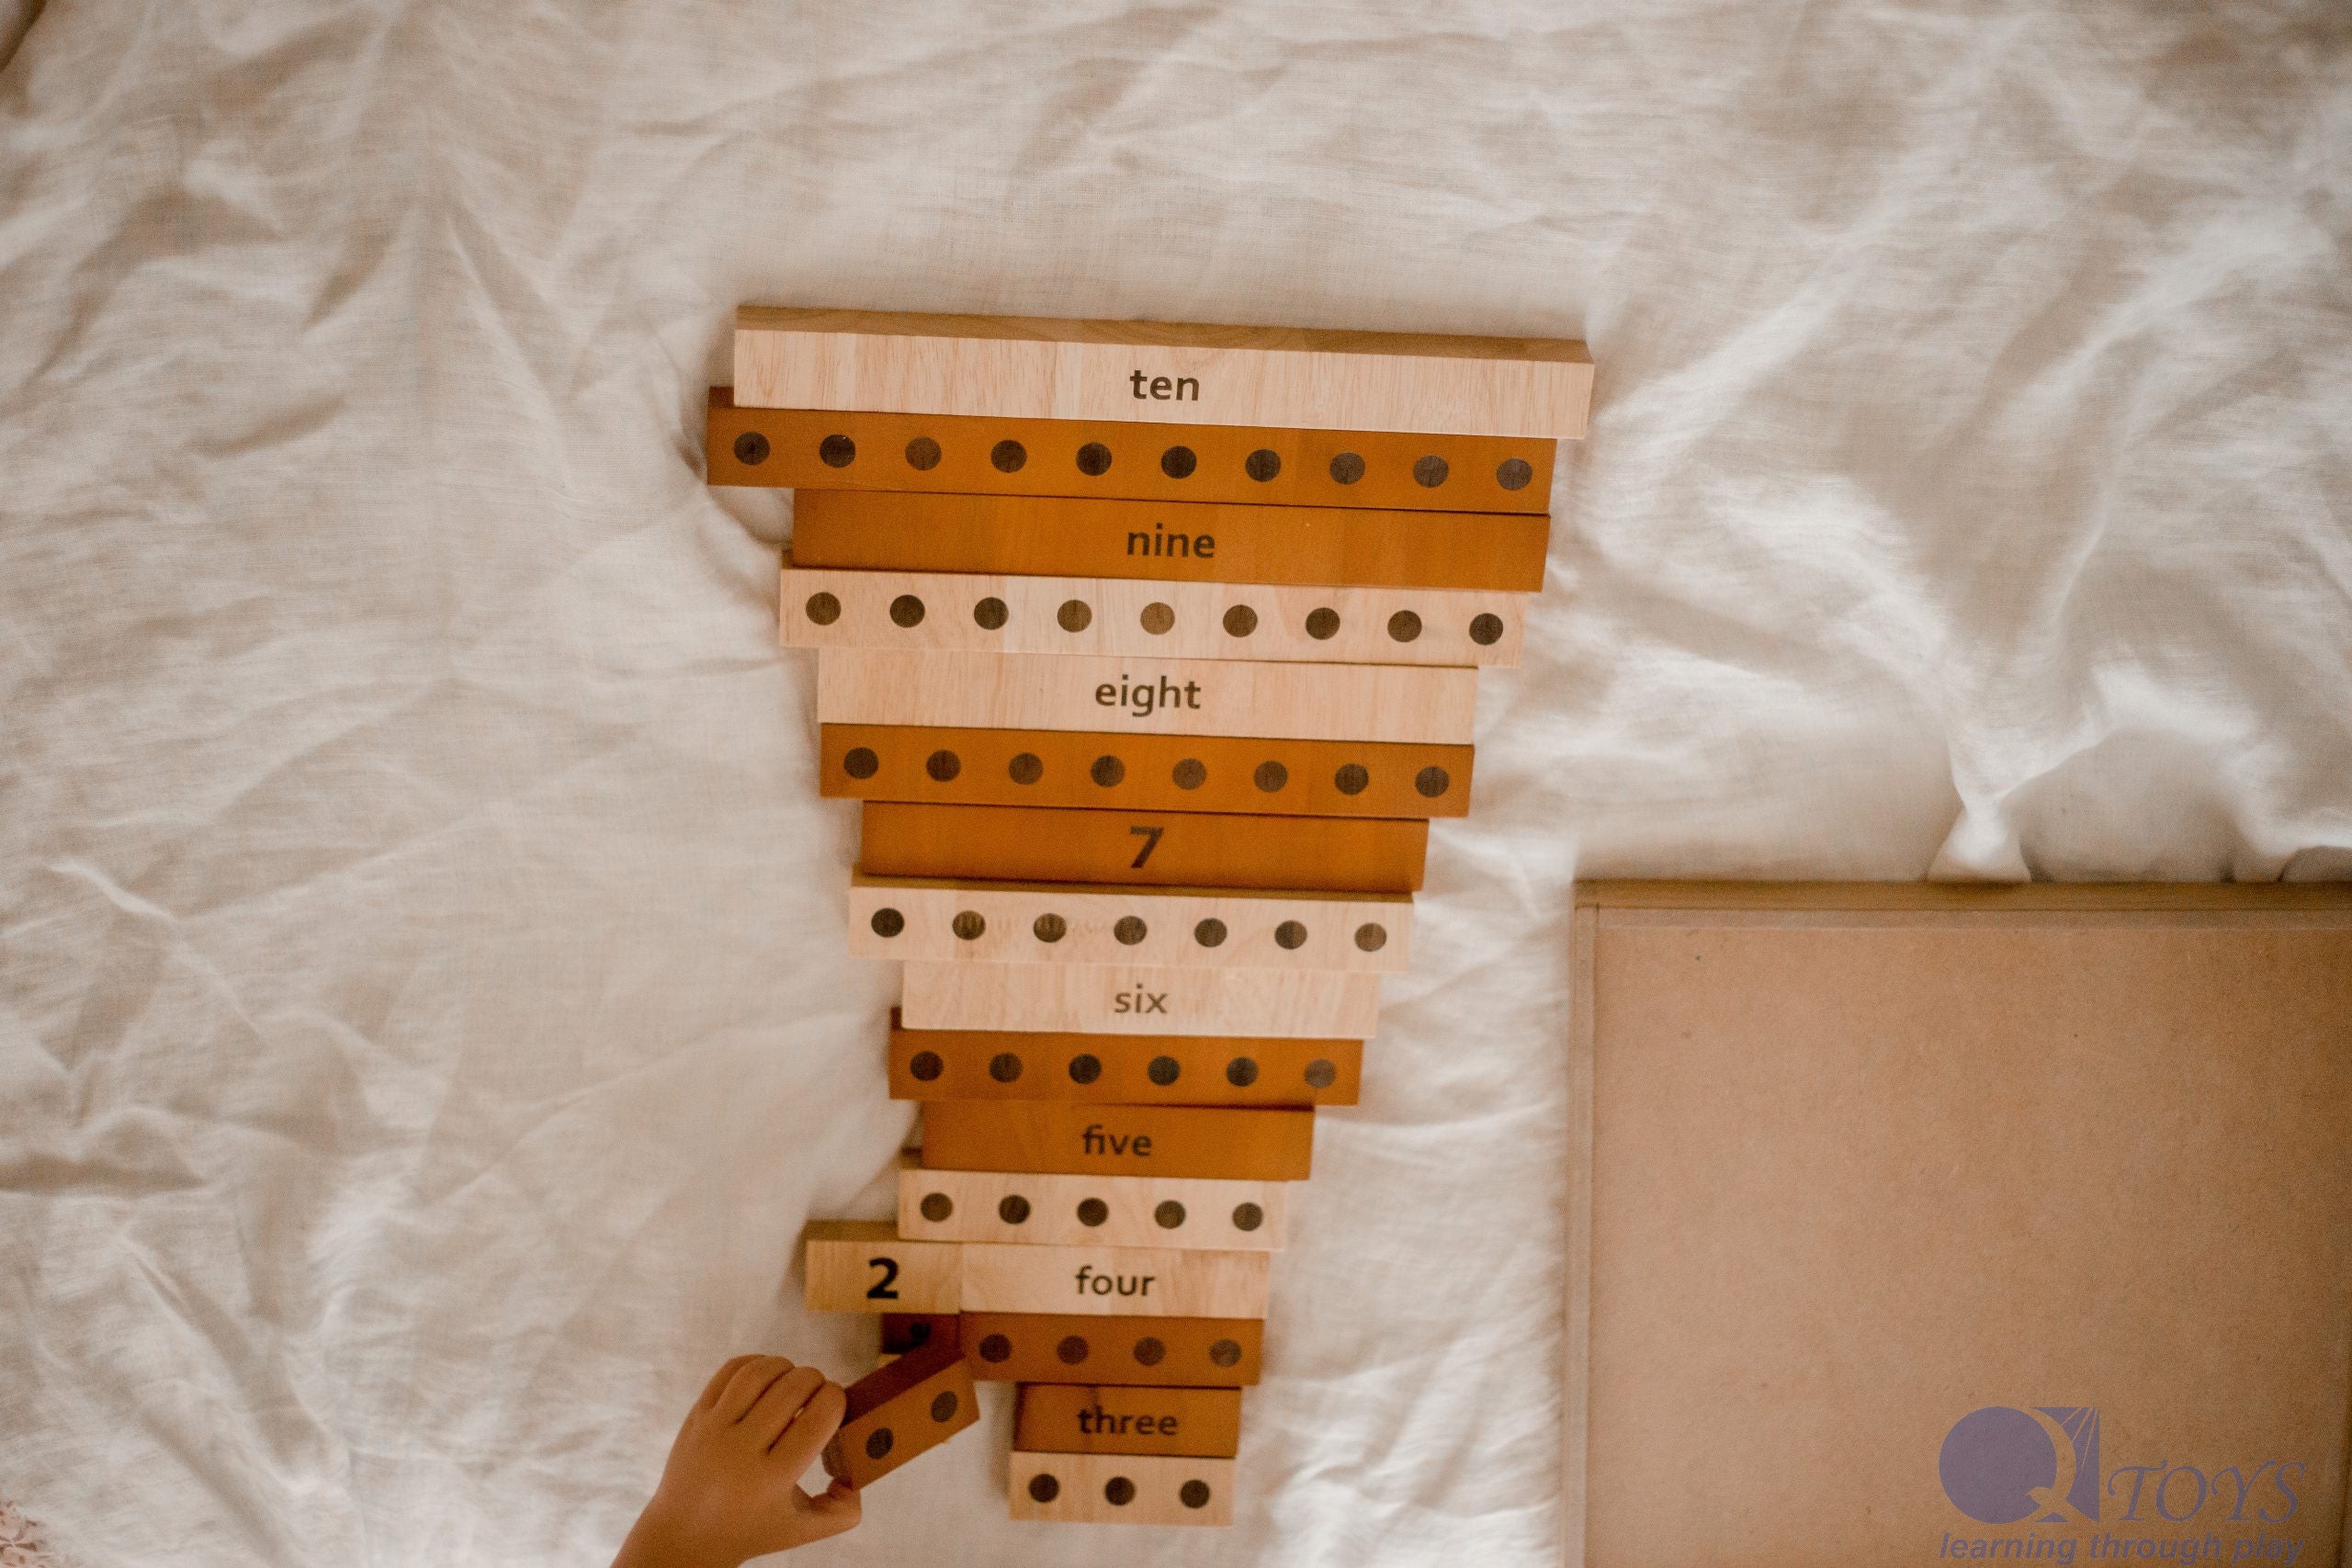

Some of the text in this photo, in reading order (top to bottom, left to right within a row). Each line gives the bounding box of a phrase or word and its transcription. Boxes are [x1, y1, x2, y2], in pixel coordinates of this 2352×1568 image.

[1129, 369, 1200, 401] ten
[1126, 522, 1216, 558] nine
[1094, 673, 1202, 717] eight
[1129, 826, 1164, 870] 7
[1114, 982, 1168, 1014] six
[1080, 1123, 1153, 1157] five
[866, 1258, 899, 1300] 2
[1075, 1264, 1156, 1297] four
[1077, 1404, 1178, 1437] three
